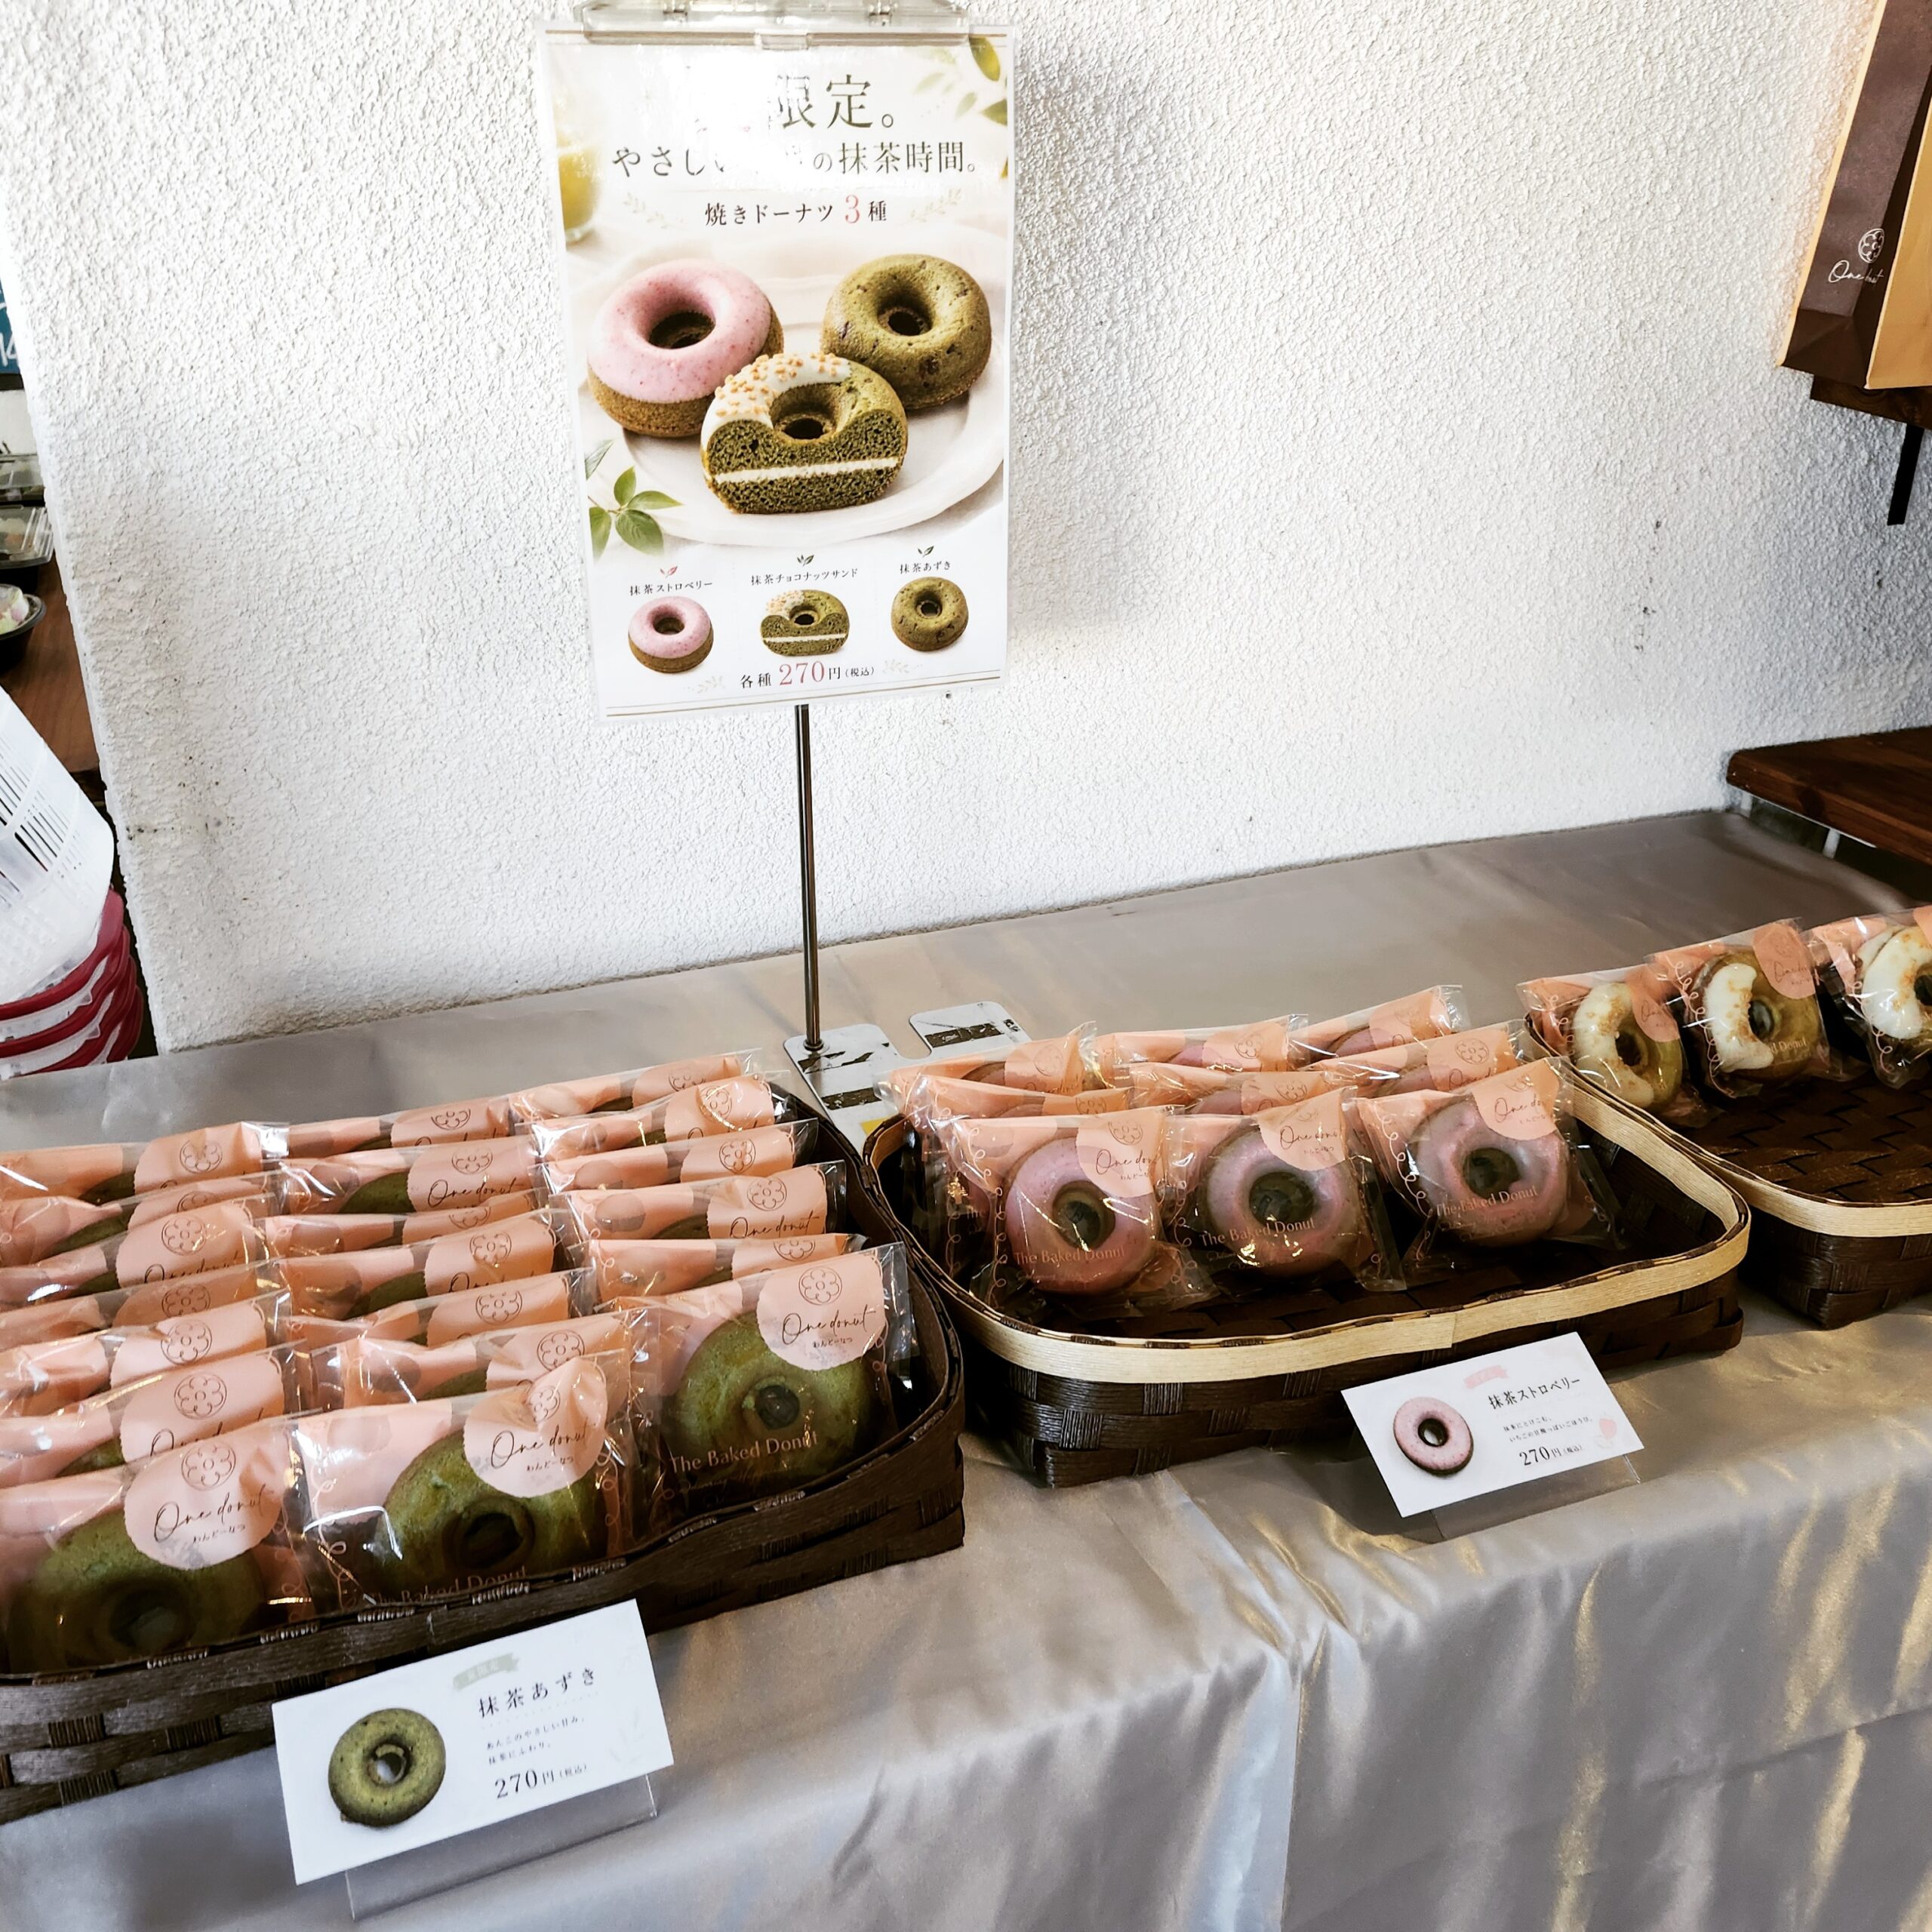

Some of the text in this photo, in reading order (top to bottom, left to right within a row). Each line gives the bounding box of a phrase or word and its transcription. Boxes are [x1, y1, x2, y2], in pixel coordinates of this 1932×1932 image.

[749, 567, 859, 586] 抹茶チョコナッツサンド
[899, 560, 952, 574] 抹茶あずき
[629, 581, 713, 596] 抹茶ストロベリー
[1498, 1186, 1538, 1204] Donut
[1199, 1217, 1315, 1247] The Baked Donut
[1084, 1245, 1125, 1260] Donut
[1487, 1377, 1580, 1409] 抹茶ストロベリー
[669, 1456, 702, 1473] The
[707, 1440, 761, 1467] Baked
[479, 1668, 594, 1718] 抹茶あずき
